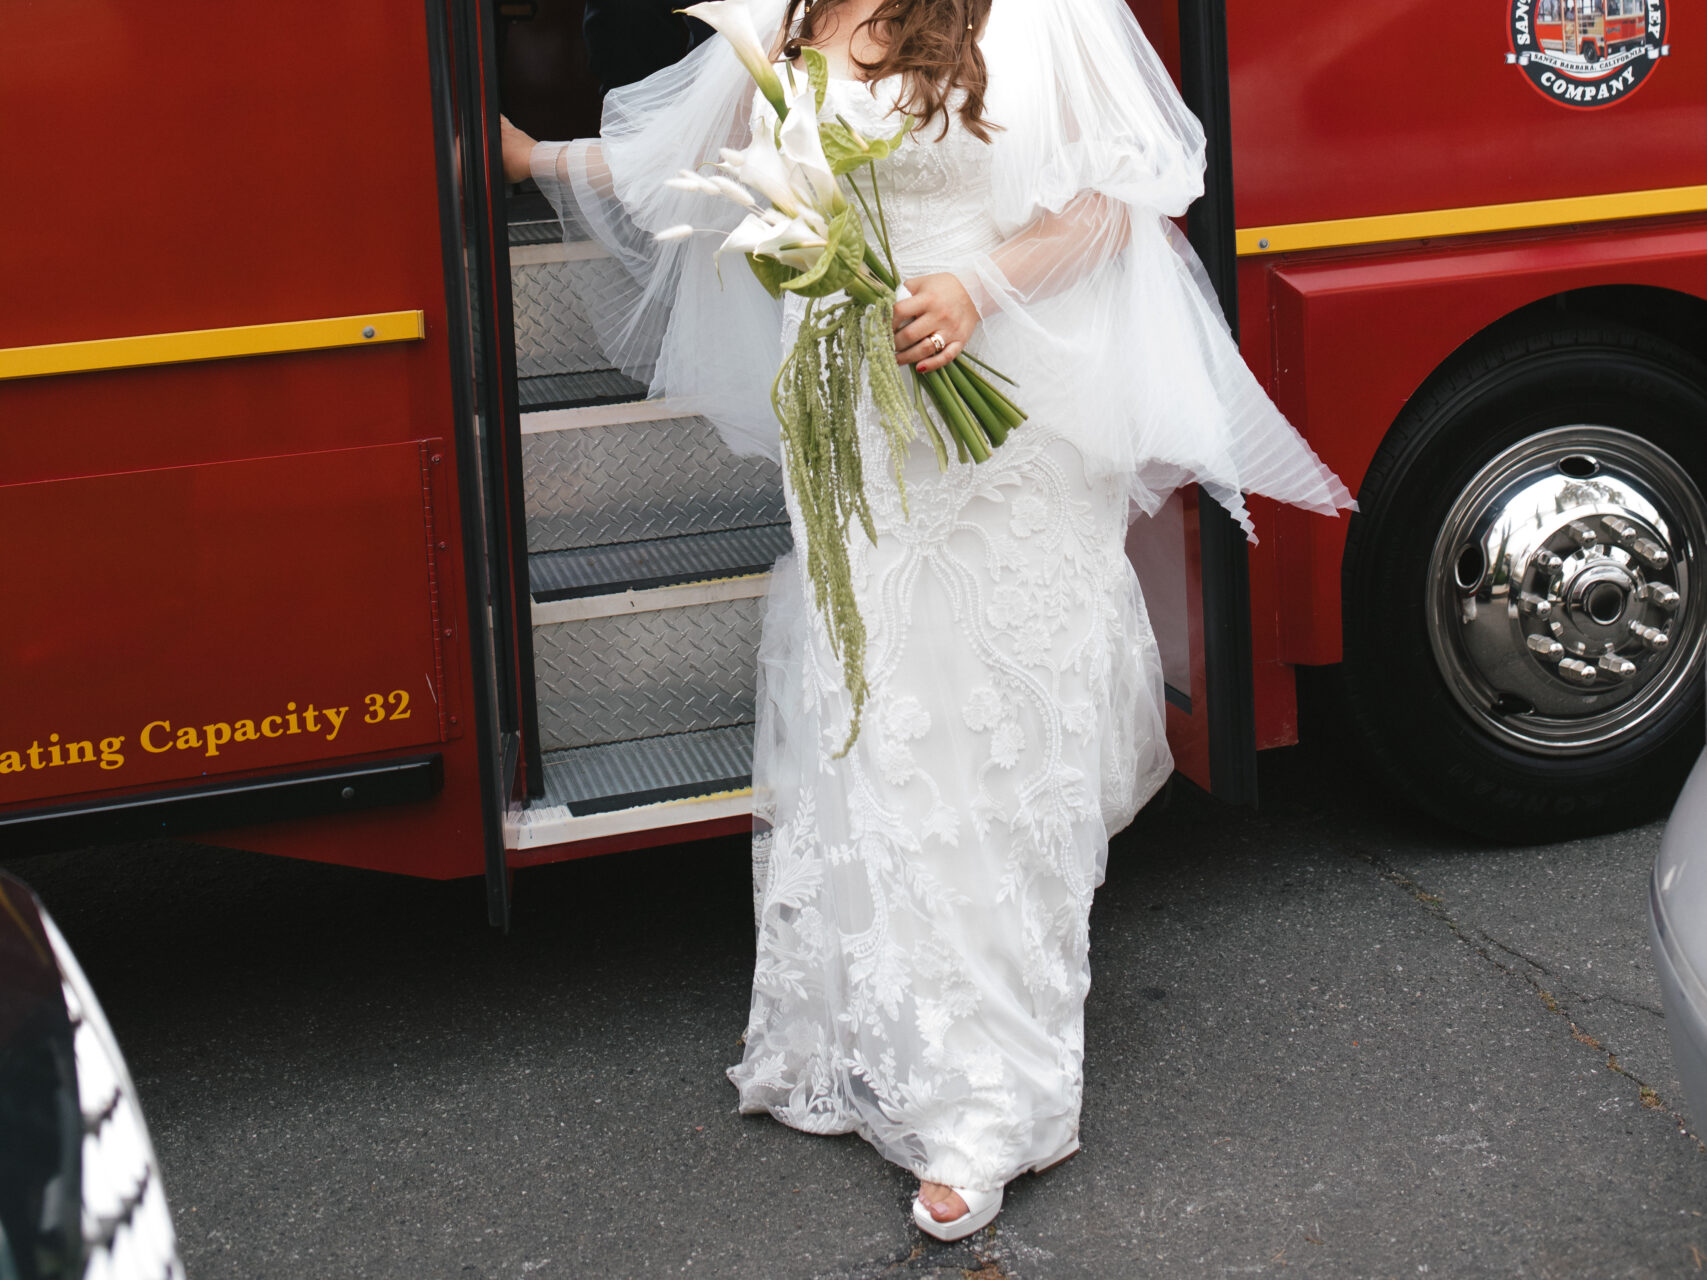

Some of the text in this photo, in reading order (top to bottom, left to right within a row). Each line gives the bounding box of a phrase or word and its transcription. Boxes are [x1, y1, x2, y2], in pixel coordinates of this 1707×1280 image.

[1533, 53, 1558, 66] SANTA
[1599, 48, 1645, 70] CALIFORNIA
[1540, 66, 1635, 101] COMPANY
[0, 689, 412, 774] ating Capacity 32
